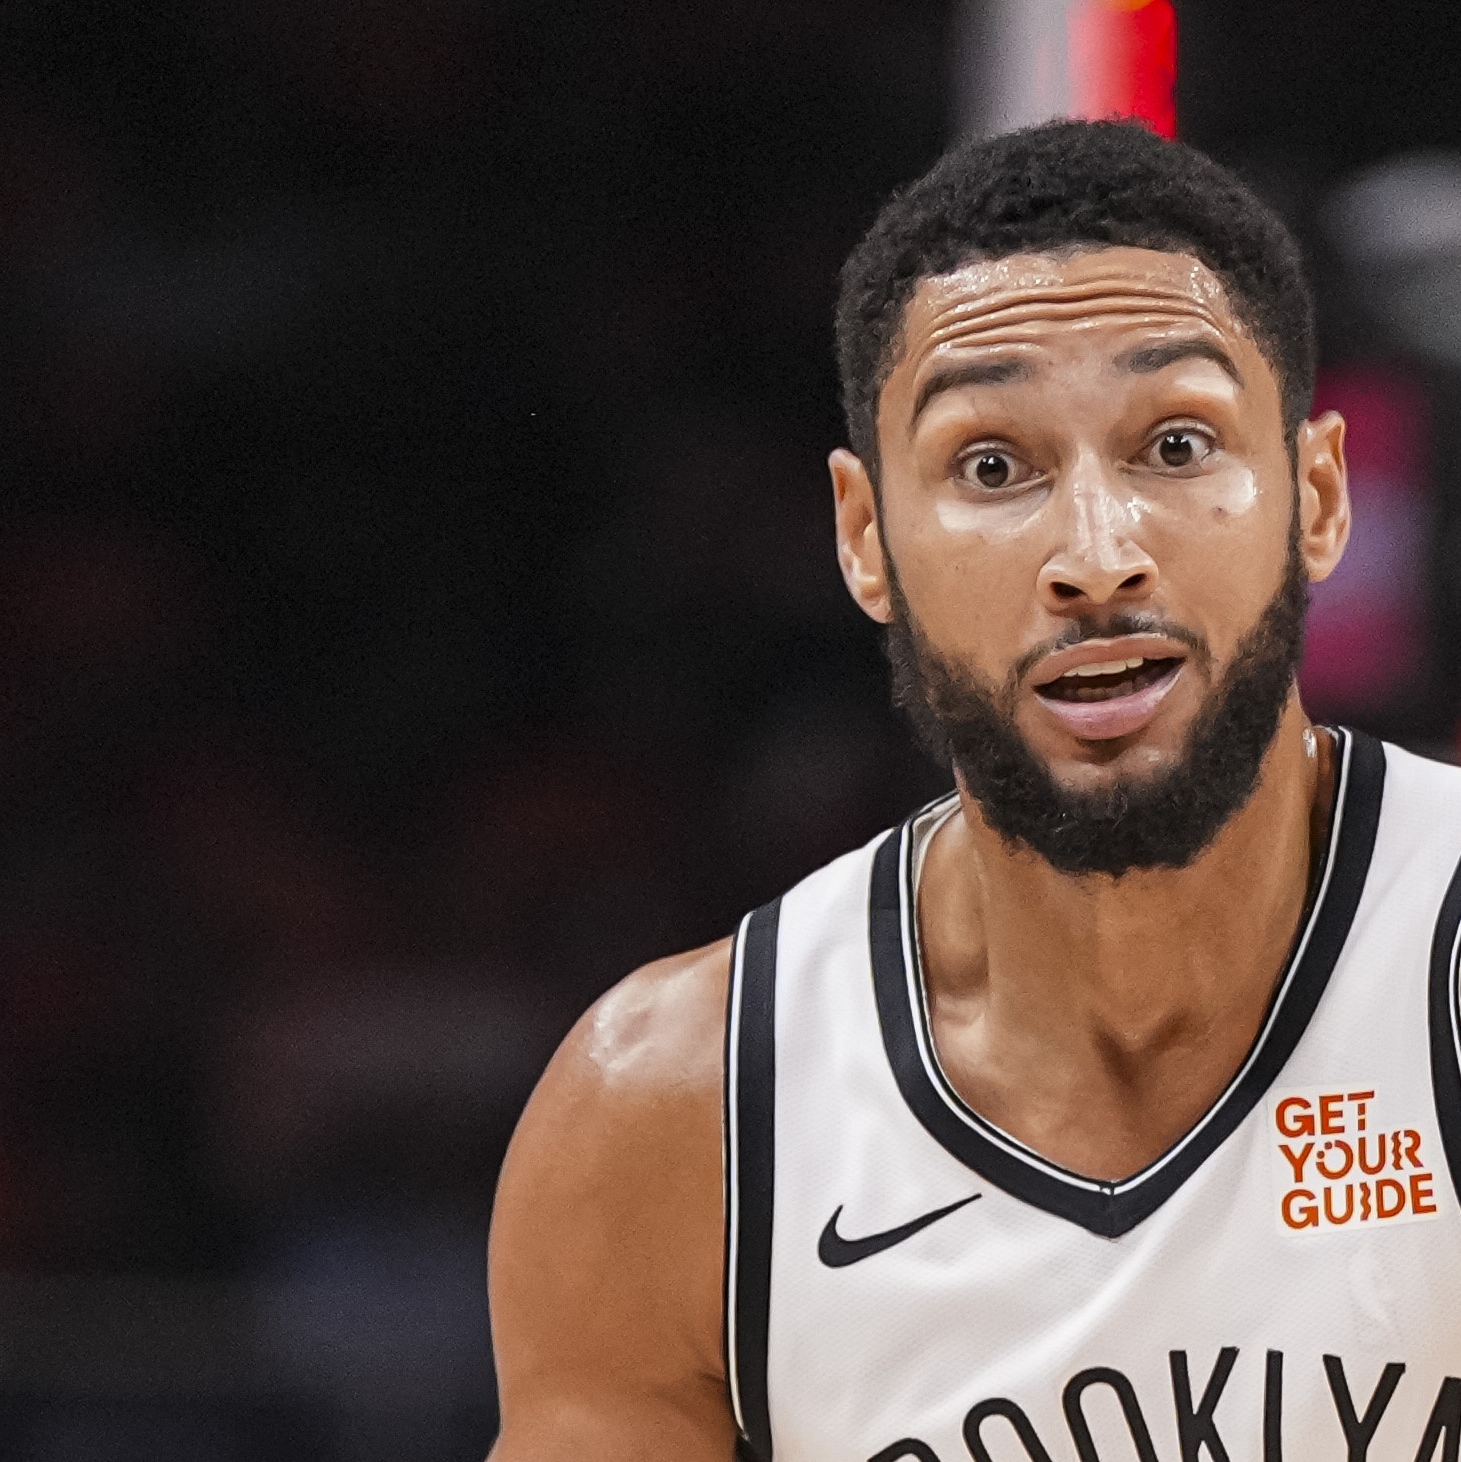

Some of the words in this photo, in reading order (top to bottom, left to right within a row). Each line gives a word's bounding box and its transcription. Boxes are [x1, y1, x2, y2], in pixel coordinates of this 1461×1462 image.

[1275, 1089, 1375, 1138] GET
[1277, 1128, 1424, 1184] YOUR
[1281, 1172, 1437, 1230] GUIDE
